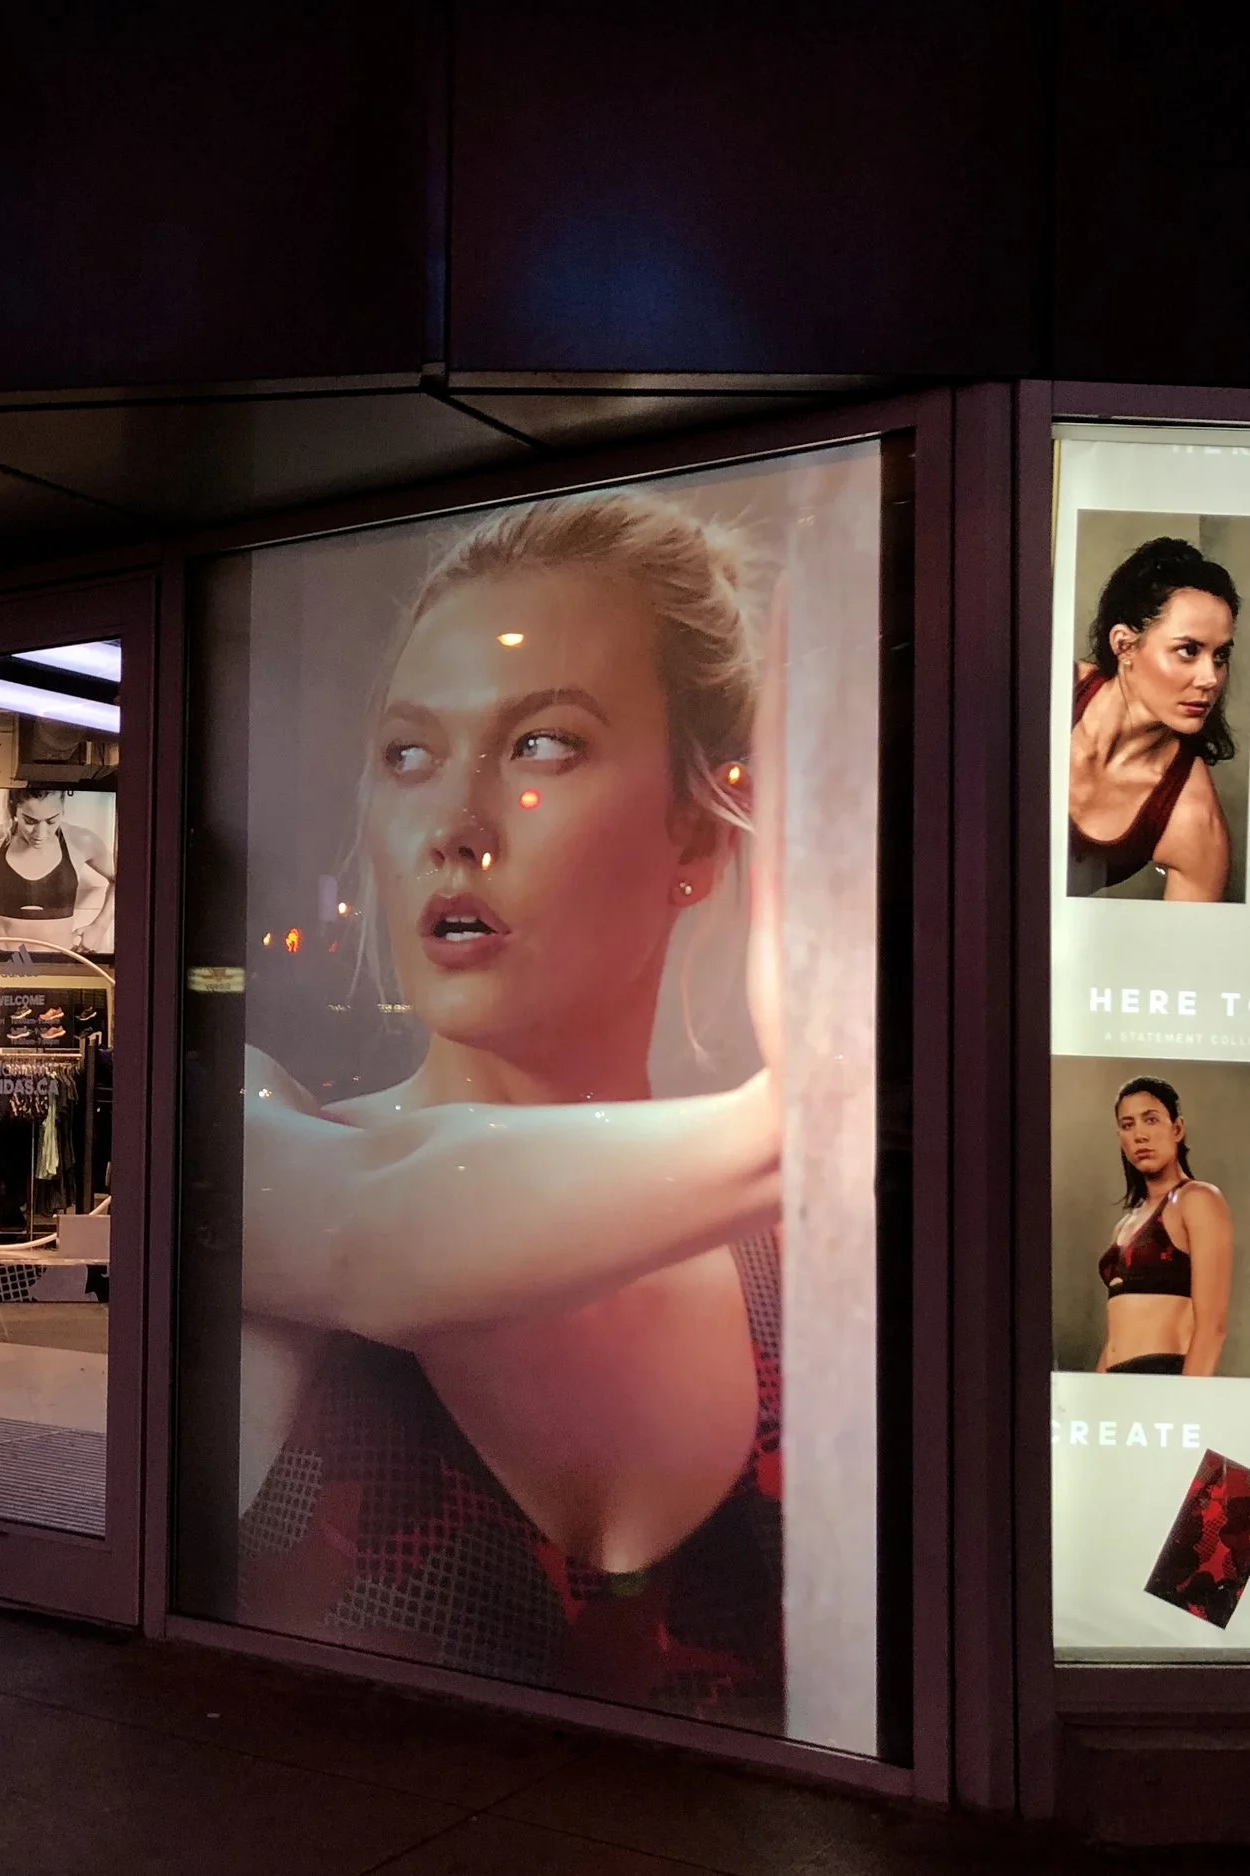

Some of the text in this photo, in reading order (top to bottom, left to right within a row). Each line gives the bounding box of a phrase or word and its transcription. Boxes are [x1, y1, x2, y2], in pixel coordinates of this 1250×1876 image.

[1089, 987, 1197, 1015] HERE
[1104, 1031, 1113, 1041] A
[1120, 1031, 1203, 1045] STATEMENT
